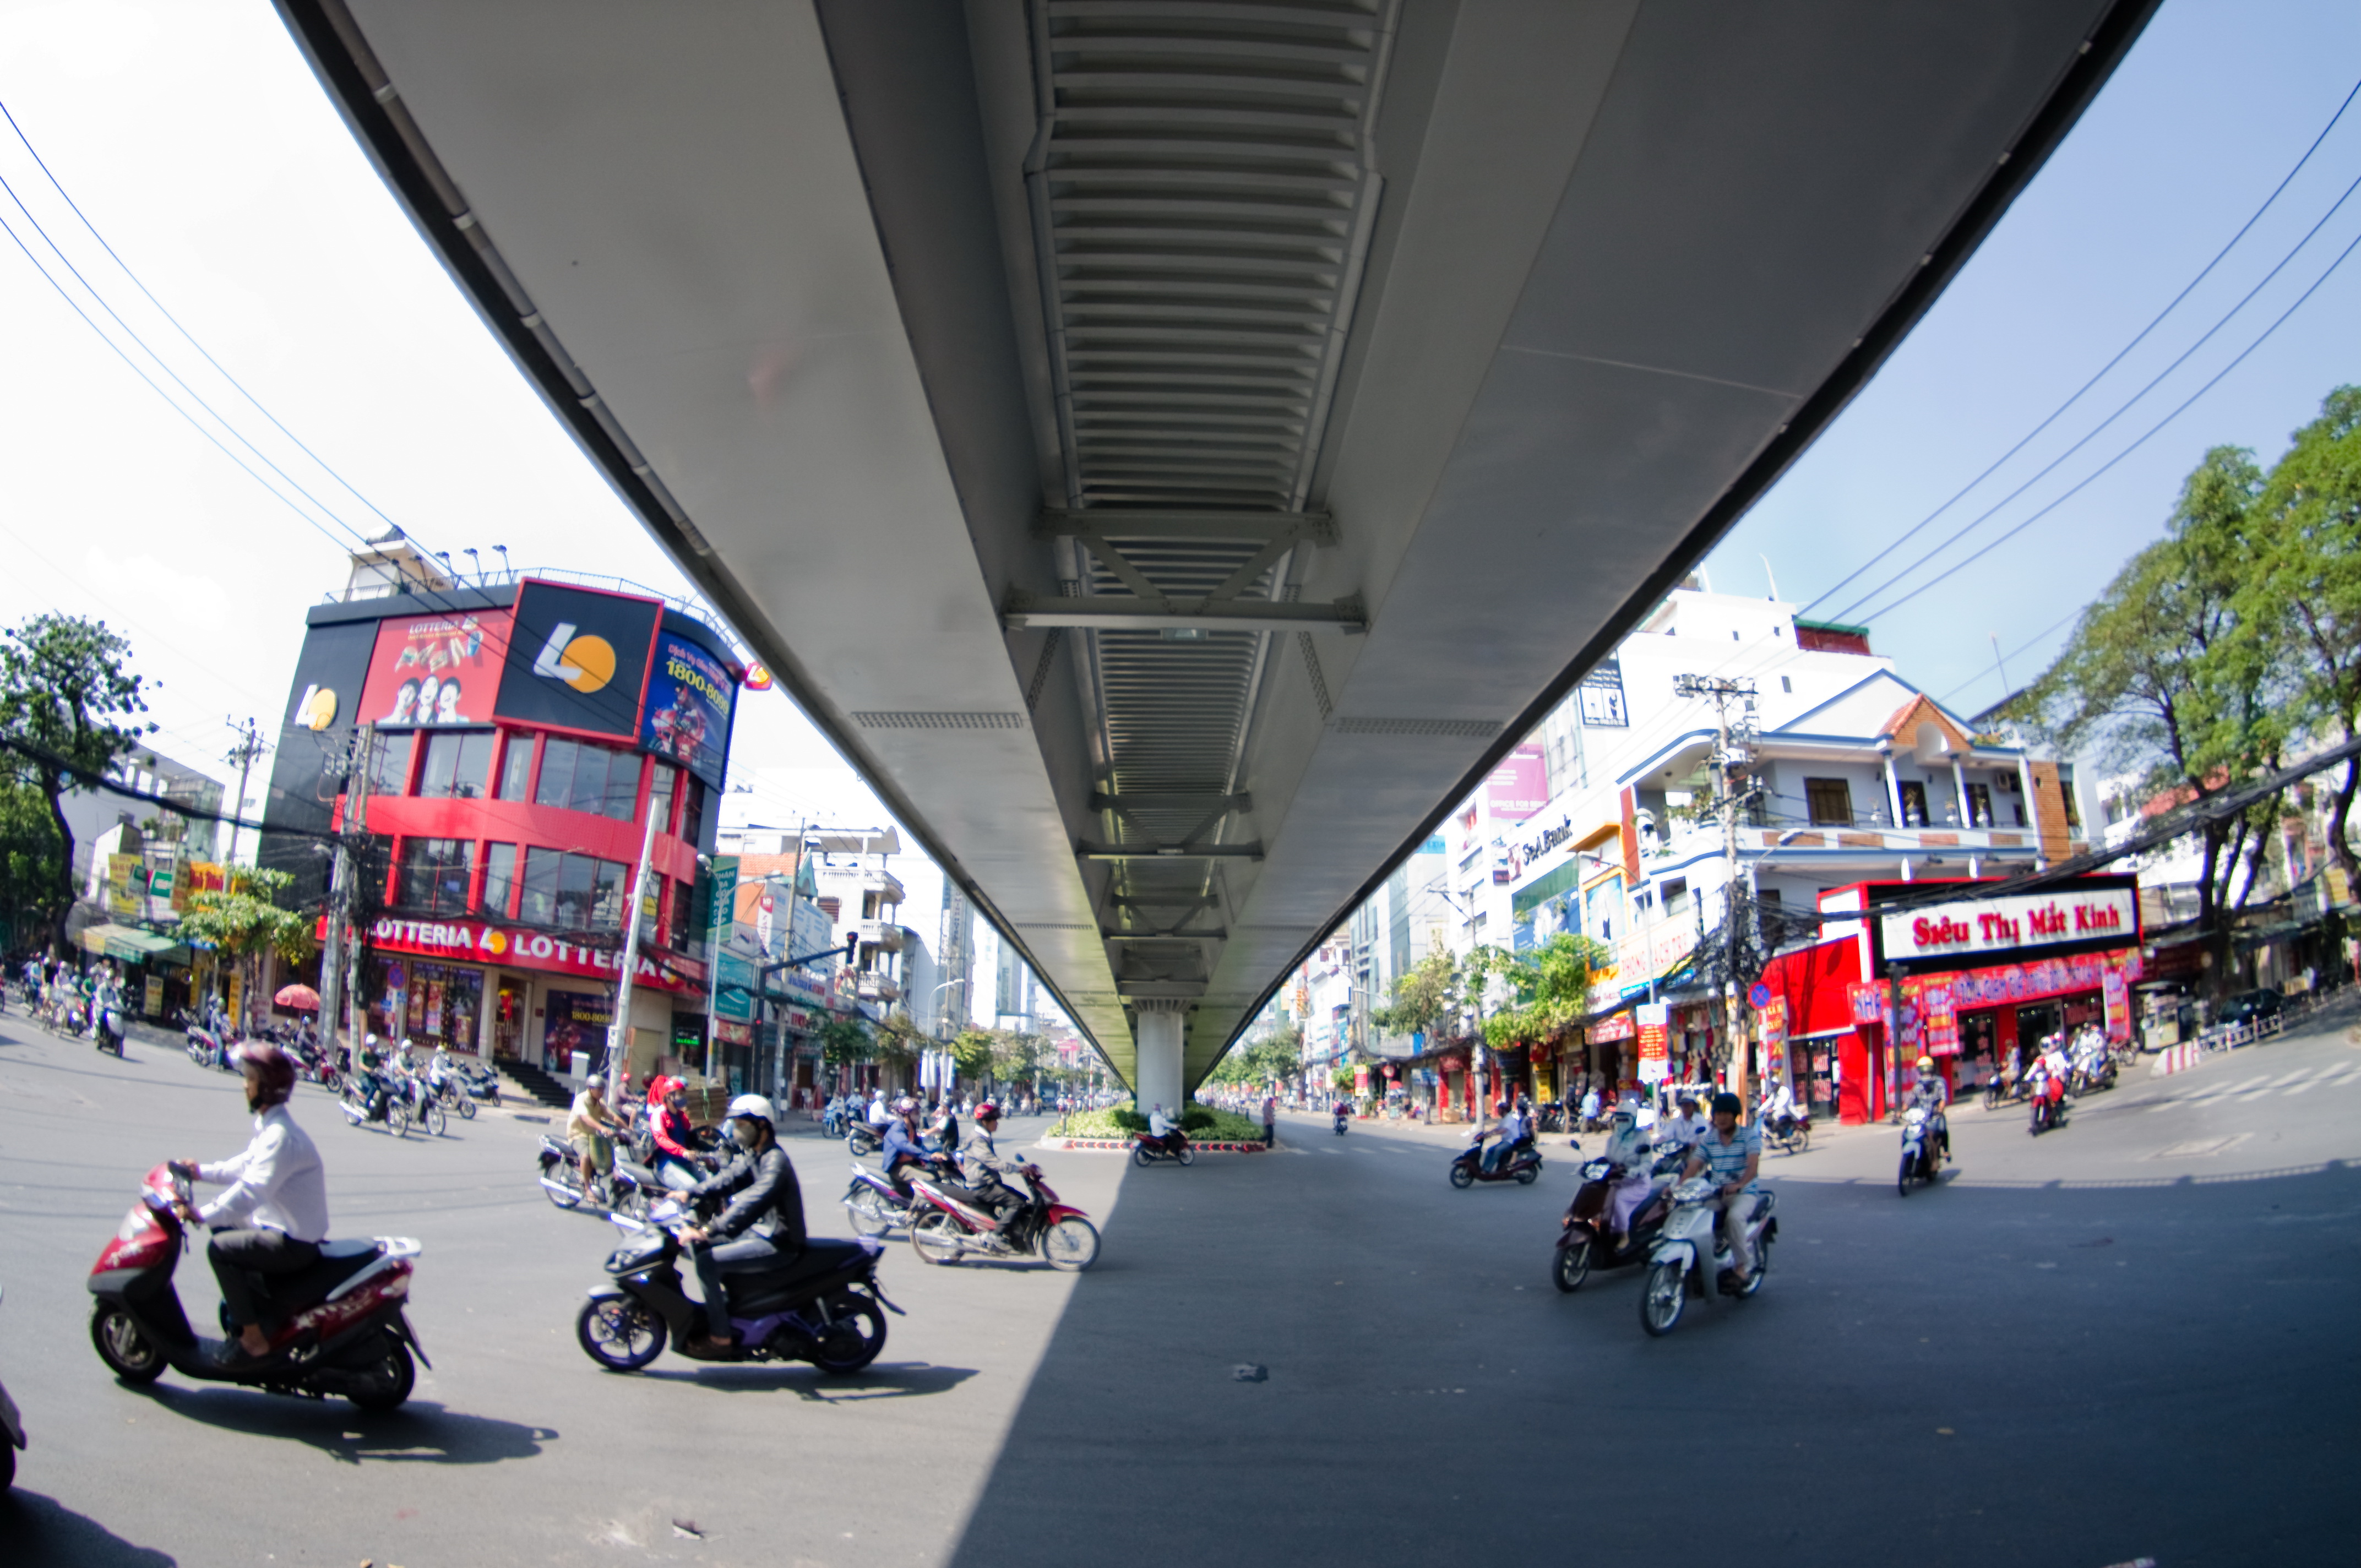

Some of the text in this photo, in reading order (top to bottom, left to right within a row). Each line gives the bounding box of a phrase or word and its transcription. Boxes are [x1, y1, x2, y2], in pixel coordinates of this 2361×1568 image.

[666, 661, 729, 715] 1800-8099
[370, 918, 473, 949] OTTERIA
[1913, 900, 2120, 946] Siêu Thị Mắt Kính
